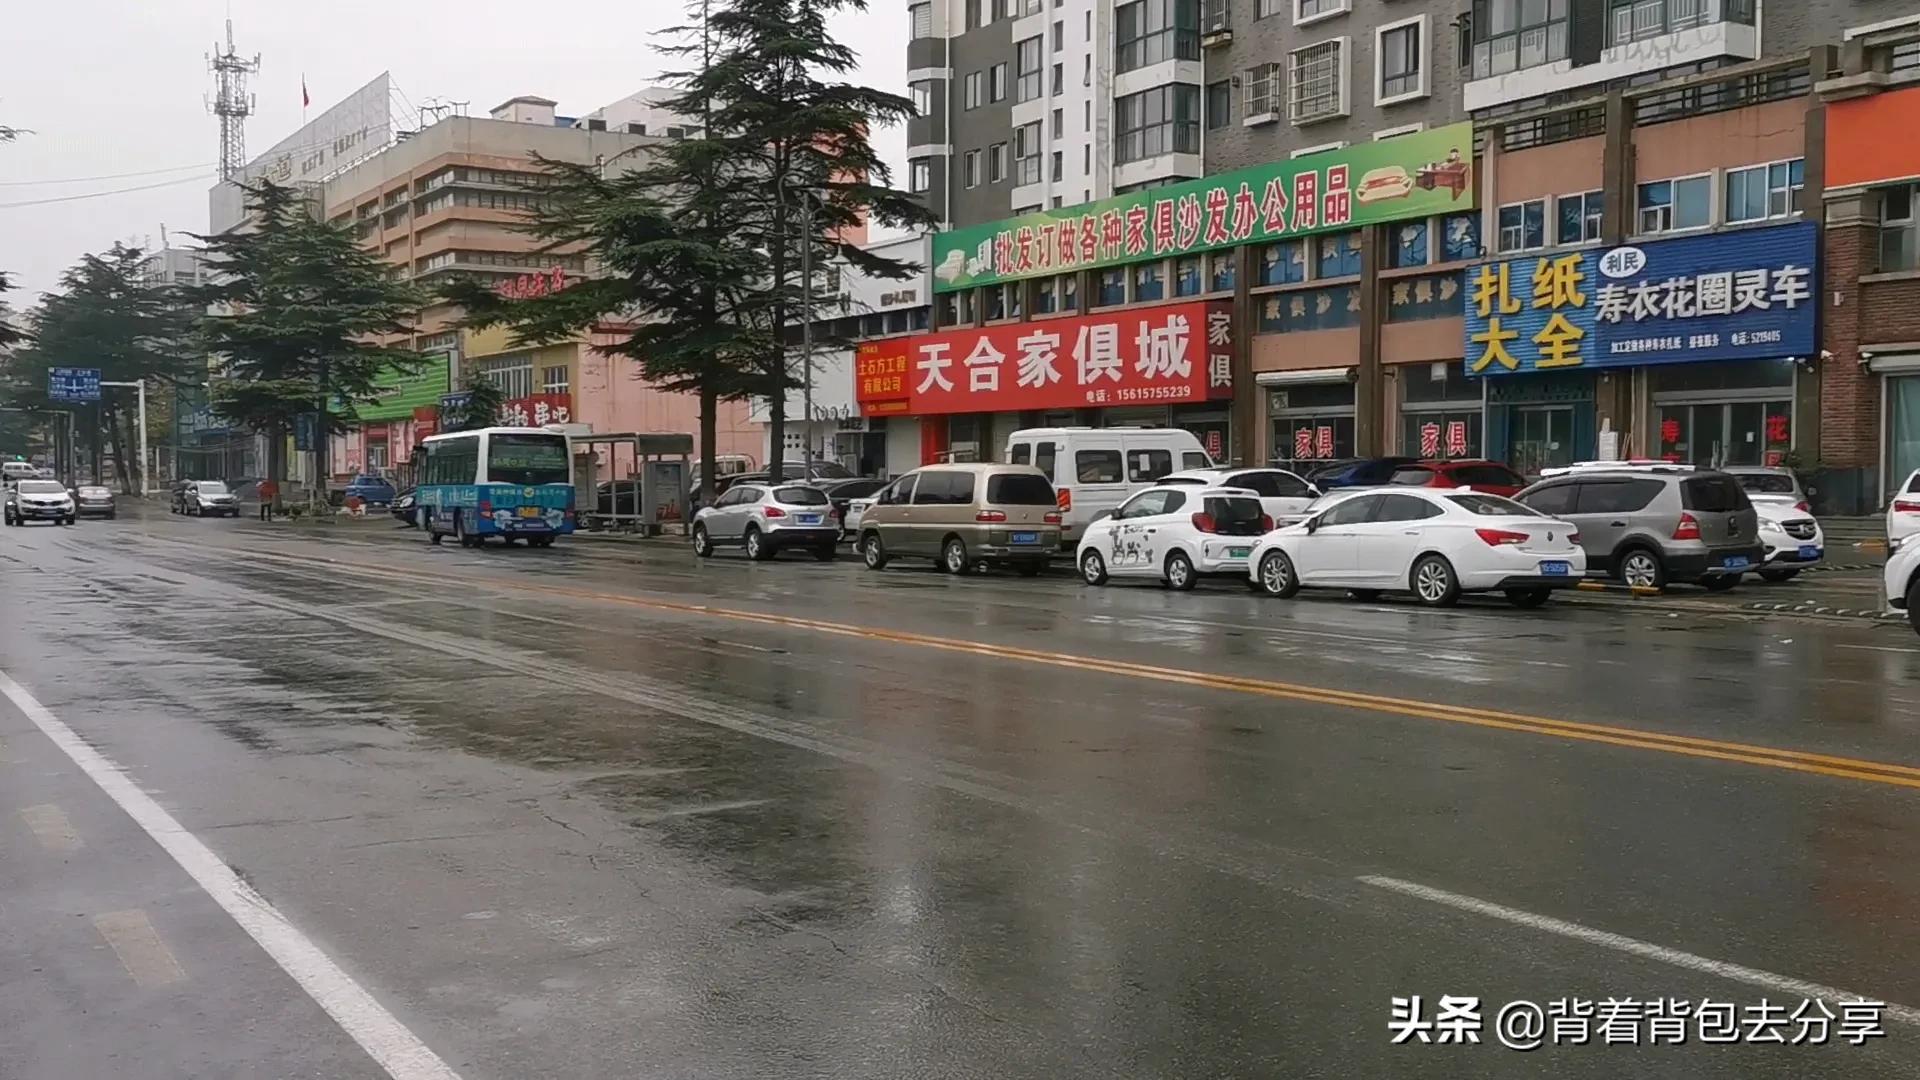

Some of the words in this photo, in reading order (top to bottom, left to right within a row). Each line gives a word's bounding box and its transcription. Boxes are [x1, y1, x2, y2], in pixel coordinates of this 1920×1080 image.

[995, 164, 1351, 276] 批发订做各种家俱沙发办公用品
[1472, 252, 1587, 318] 扎纸
[1606, 252, 1640, 272] 利民
[1595, 265, 1811, 323] 寿衣花圈灵车
[916, 314, 1192, 393] 天合家俱城
[1208, 311, 1232, 388] 家俱
[1471, 313, 1586, 372] 大全
[864, 376, 901, 394] 有限公司
[1295, 425, 1334, 459] 家俱
[1420, 421, 1467, 457] 家俱
